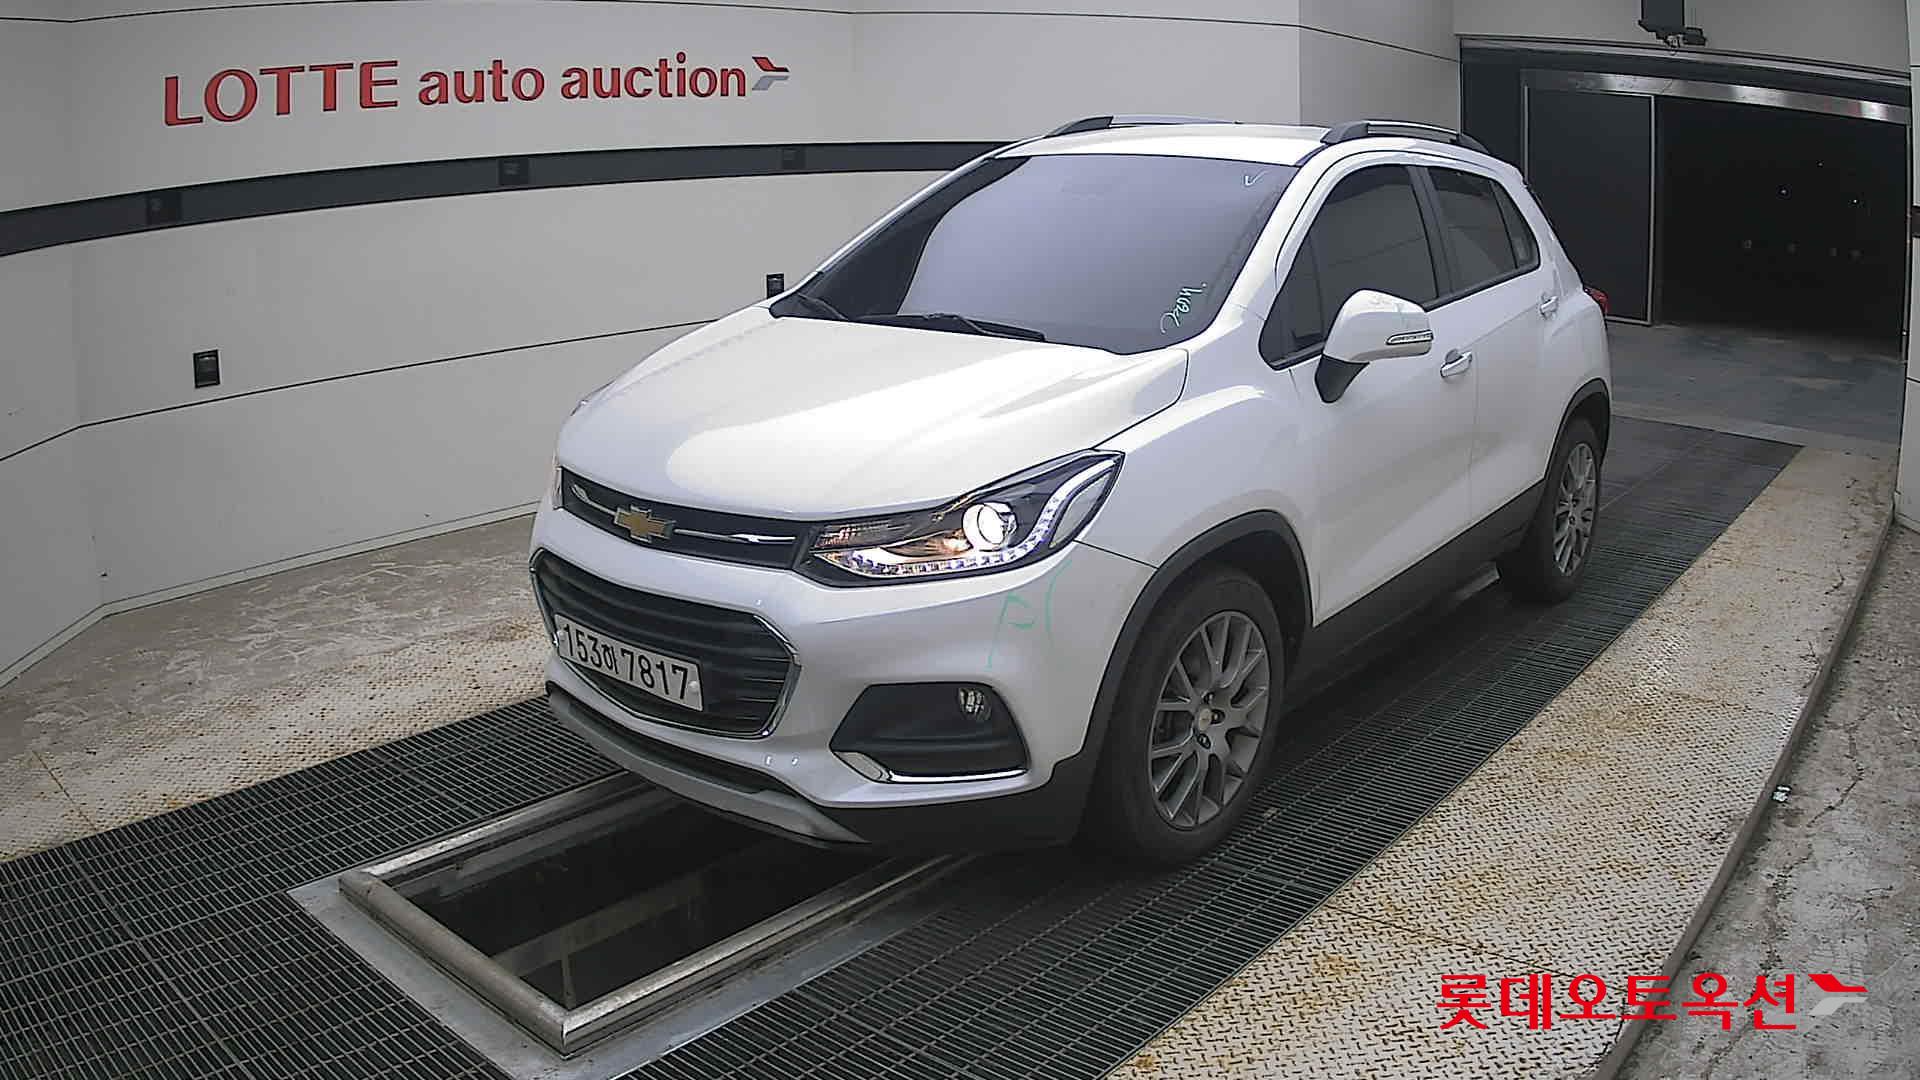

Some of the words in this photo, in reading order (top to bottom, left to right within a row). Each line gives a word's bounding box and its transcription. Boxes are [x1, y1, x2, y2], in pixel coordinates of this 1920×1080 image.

[164, 60, 399, 127] LOTTE
[417, 58, 546, 106] auto
[561, 51, 747, 100] auction
[622, 649, 689, 701] 7817
